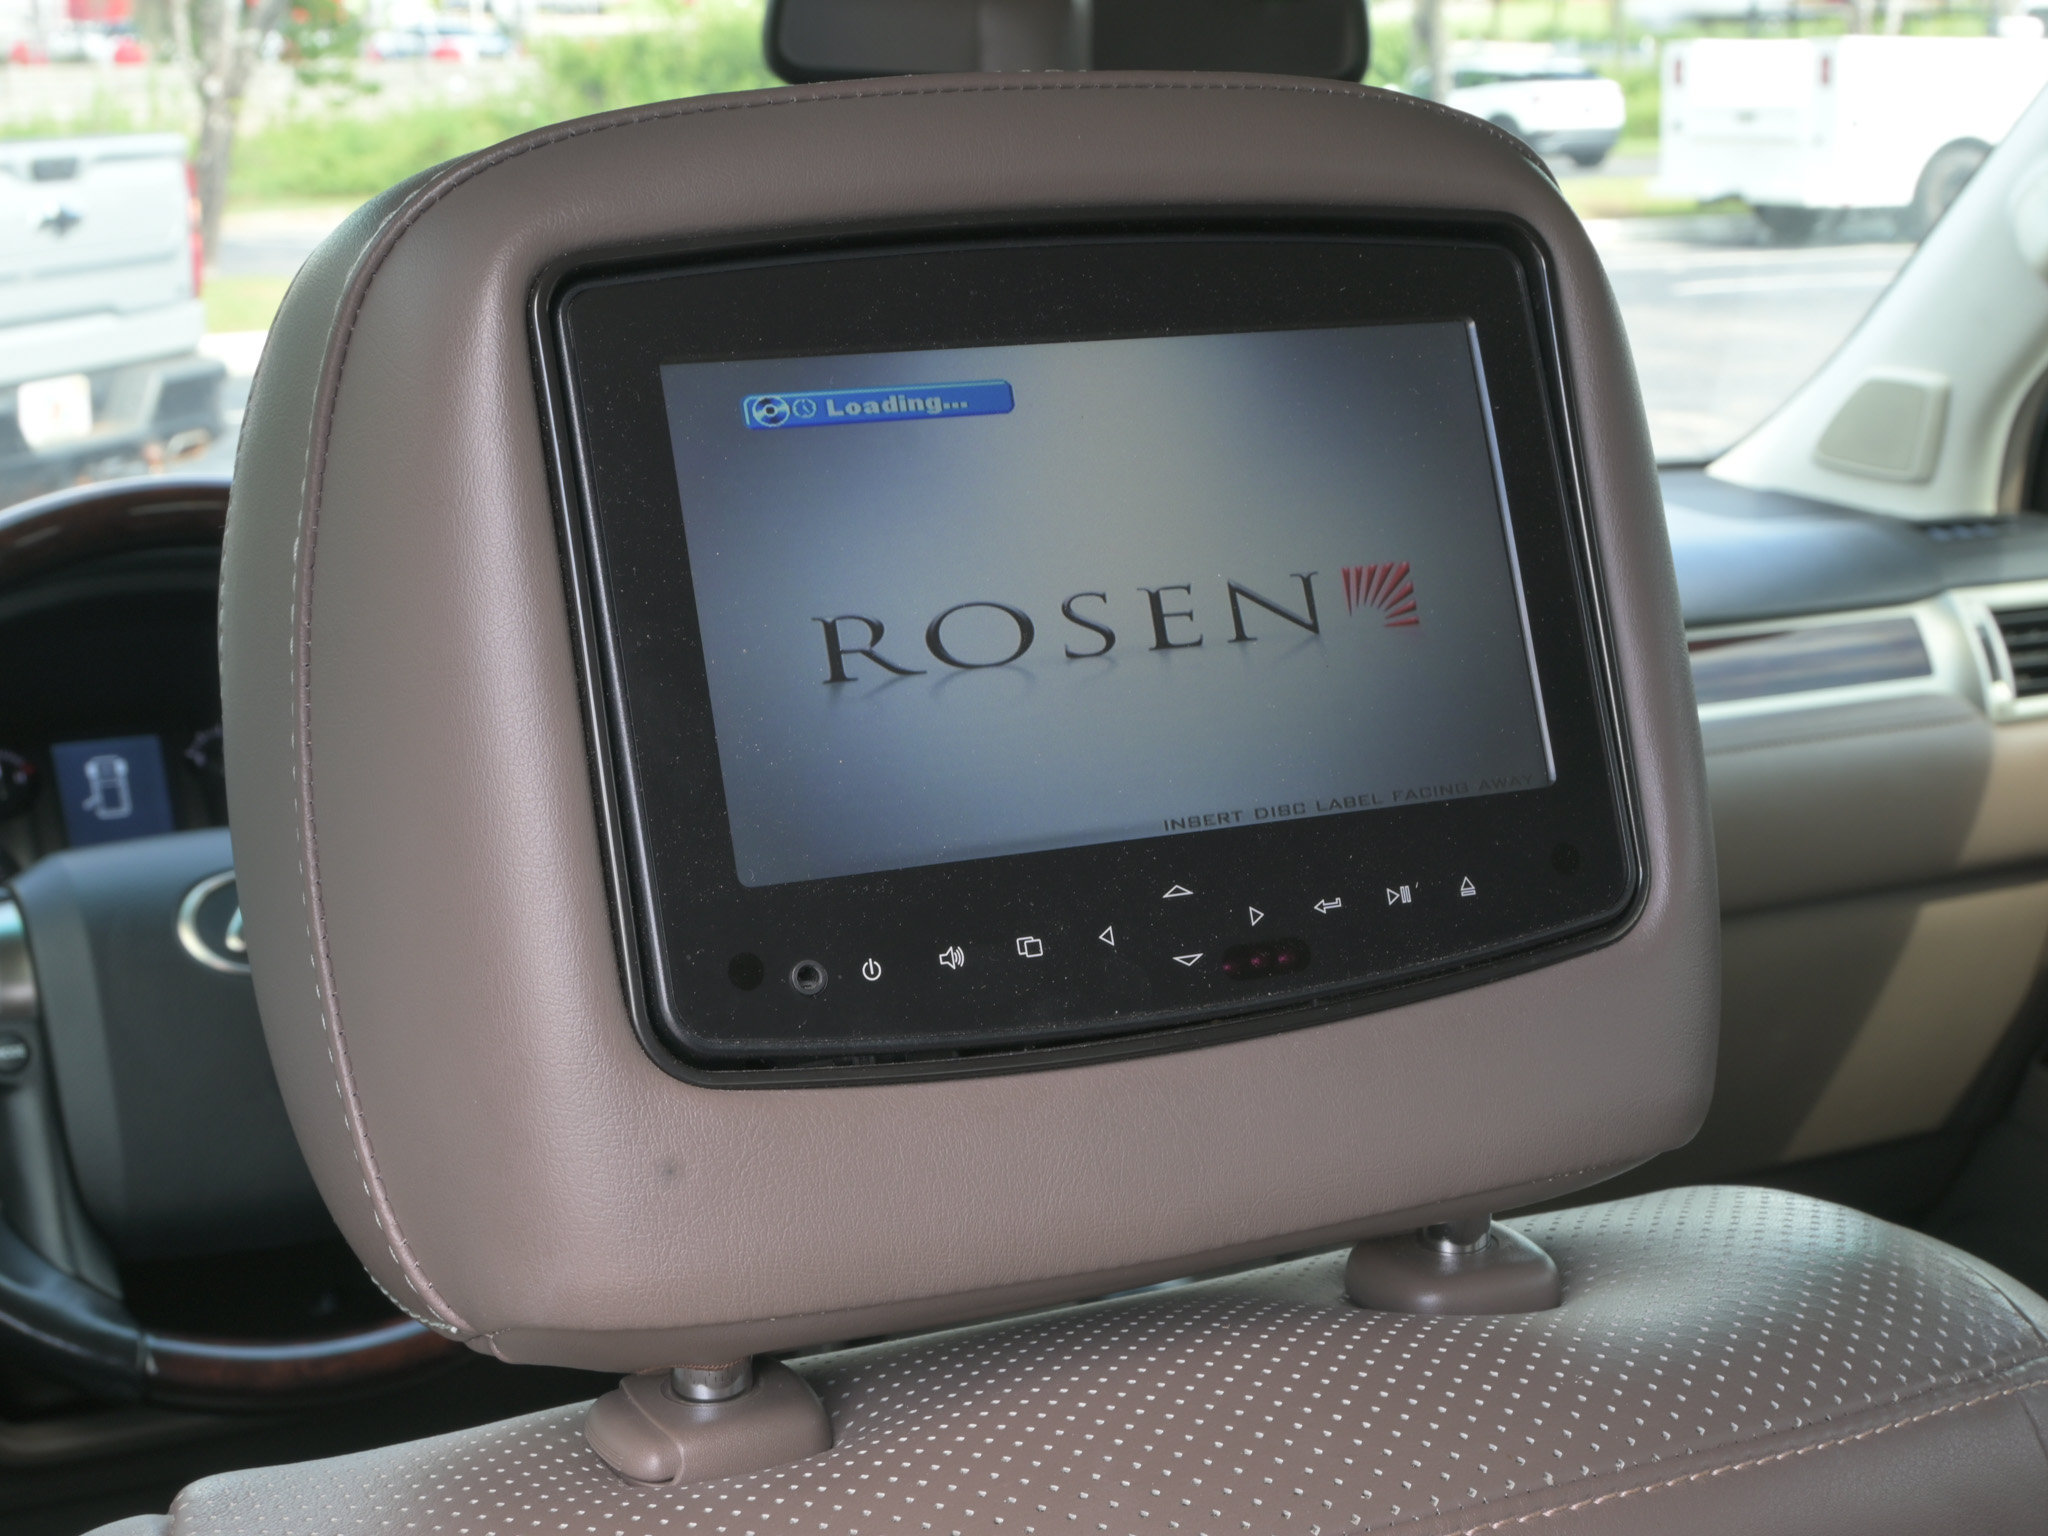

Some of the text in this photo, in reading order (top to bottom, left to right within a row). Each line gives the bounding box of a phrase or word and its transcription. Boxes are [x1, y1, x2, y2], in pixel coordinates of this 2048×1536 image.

[826, 395, 969, 417] Loading...
[811, 571, 1320, 684] ROSEN
[1164, 774, 1534, 831] INSERT DISC LABEL FACING AWAY
